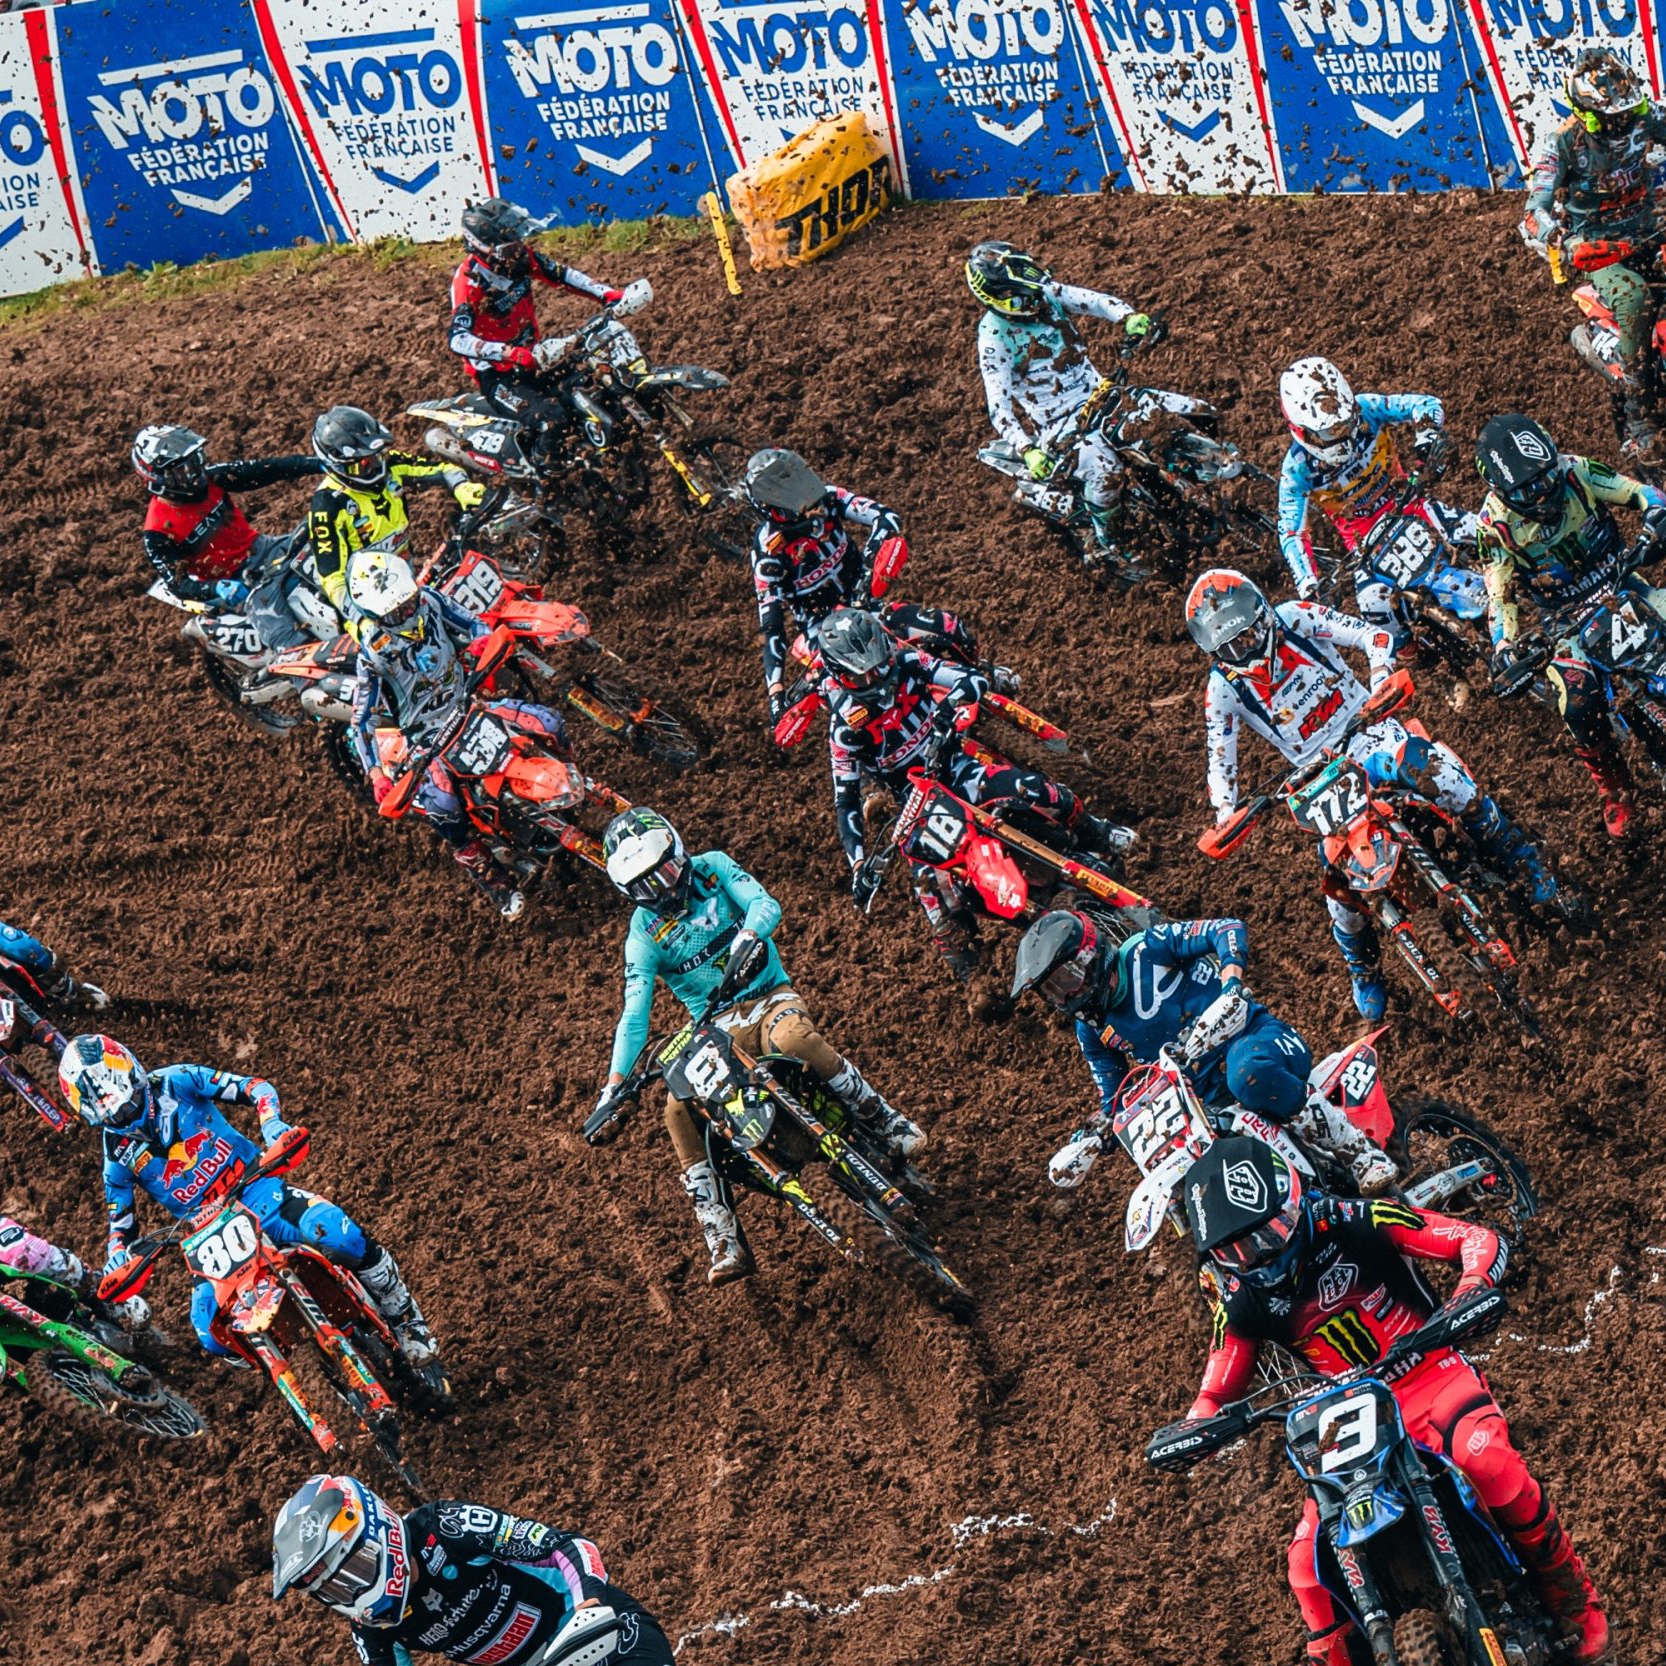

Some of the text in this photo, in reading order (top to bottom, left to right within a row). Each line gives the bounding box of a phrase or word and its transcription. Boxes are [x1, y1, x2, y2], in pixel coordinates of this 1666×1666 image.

[709, 8, 868, 77] MOTO
[903, 0, 1066, 62] MOTO
[503, 23, 678, 98] MOTO
[936, 60, 1058, 87] FÉDÉRATION
[1120, 60, 1232, 81] FÉDÉRATION
[1313, 47, 1441, 74] FÉDÉRATION
[297, 50, 462, 118] MOTO
[743, 76, 864, 102] FÉDÉRATION
[949, 84, 1056, 108] FRANÇAISE
[1133, 80, 1232, 102] FRANÇAISE
[1327, 73, 1438, 98] FRANÇAISE
[88, 67, 274, 150] MOTO
[537, 92, 669, 121] FÉDÉRATION
[756, 98, 862, 120] FRANÇAISE
[334, 116, 456, 142] FÉDÉRATION
[550, 112, 667, 141] FRANÇAISE
[128, 132, 268, 170] FÉDÉRATION
[345, 136, 454, 160] FRANÇAISE
[143, 152, 267, 187] FRANÇAISE
[312, 510, 333, 557] FOX
[795, 541, 848, 589] HONDA
[1612, 600, 1647, 660] 4
[1306, 772, 1367, 836] 172
[920, 811, 963, 859] 18
[1342, 1059, 1375, 1099] 22
[282, 1130, 301, 1148] KTM
[172, 1171, 209, 1204] Red
[204, 1138, 232, 1179] Bull
[197, 1214, 257, 1278] 80
[101, 1277, 119, 1294] KTM
[1450, 1295, 1500, 1330] ACERBIS
[1151, 1436, 1203, 1460] ACERBIS
[382, 1504, 407, 1597] Red Bull
[450, 1584, 512, 1655] Husqvarna
